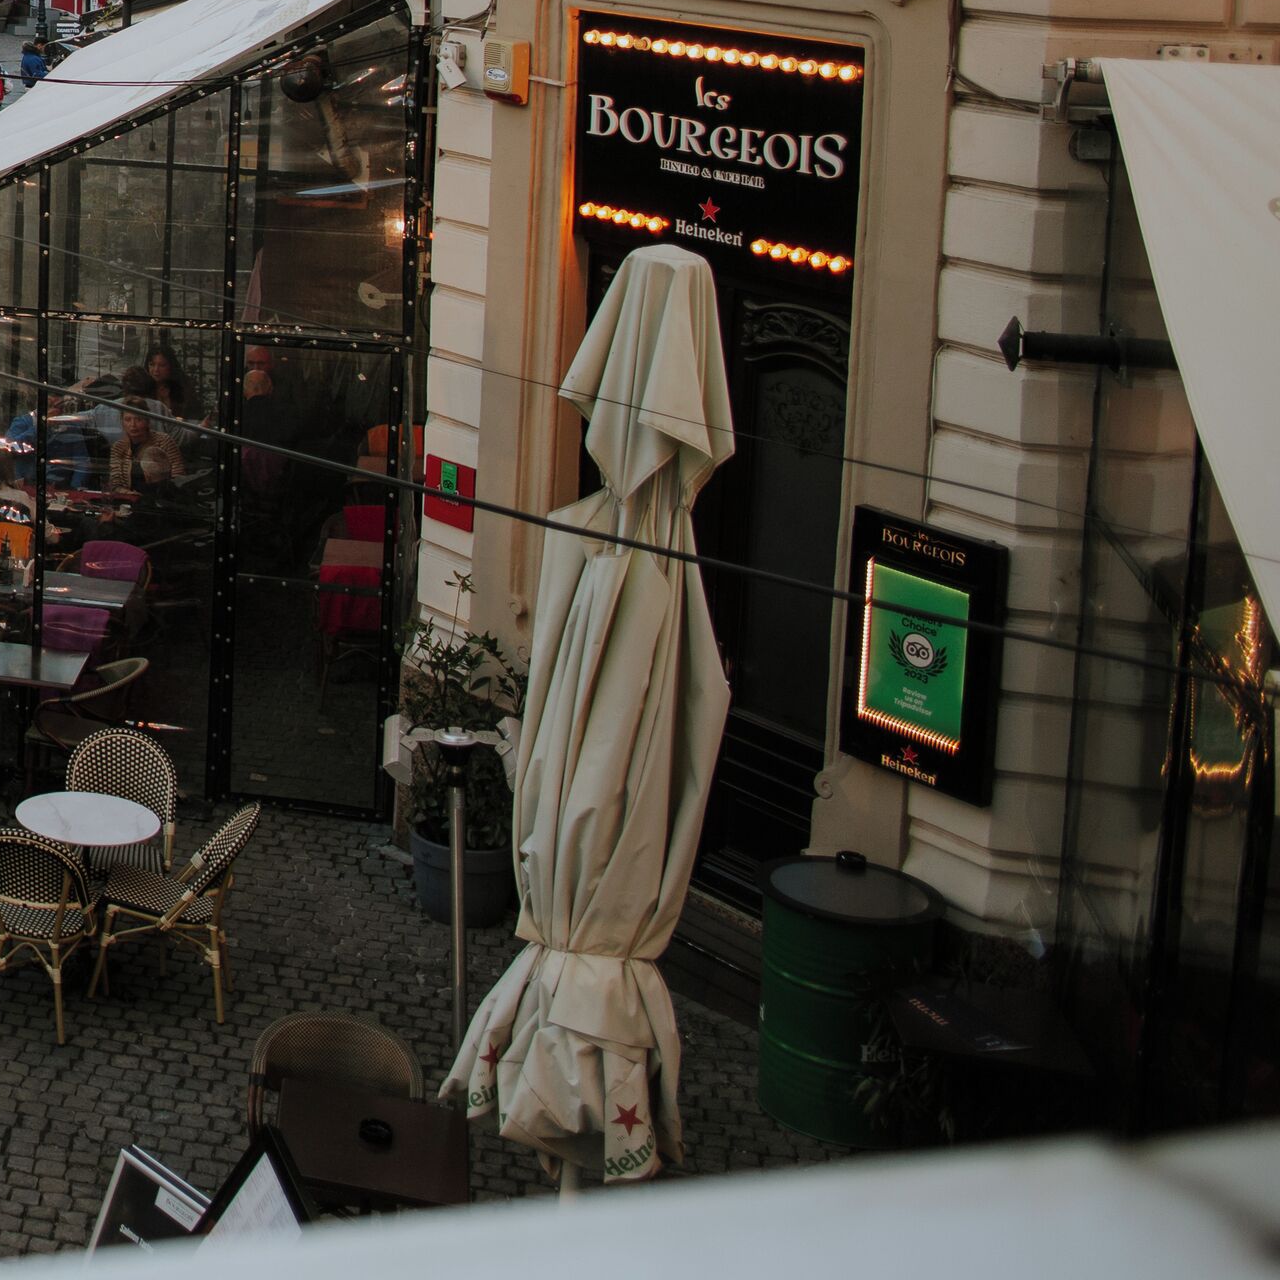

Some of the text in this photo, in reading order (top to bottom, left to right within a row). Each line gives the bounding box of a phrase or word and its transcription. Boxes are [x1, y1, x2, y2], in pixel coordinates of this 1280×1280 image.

[695, 76, 732, 111] les
[586, 94, 848, 179] BOURGEOIS
[660, 158, 700, 178] BISTRO
[701, 167, 712, 179] &
[740, 174, 766, 189] BAR
[675, 219, 743, 247] Heineken
[882, 527, 967, 567] BOURGEOIS
[901, 617, 937, 637] Choice
[904, 668, 929, 684] 2023
[902, 687, 928, 701] Review
[905, 695, 924, 706] us on
[881, 753, 937, 787] Heineken
[605, 1125, 655, 1177] Heine
